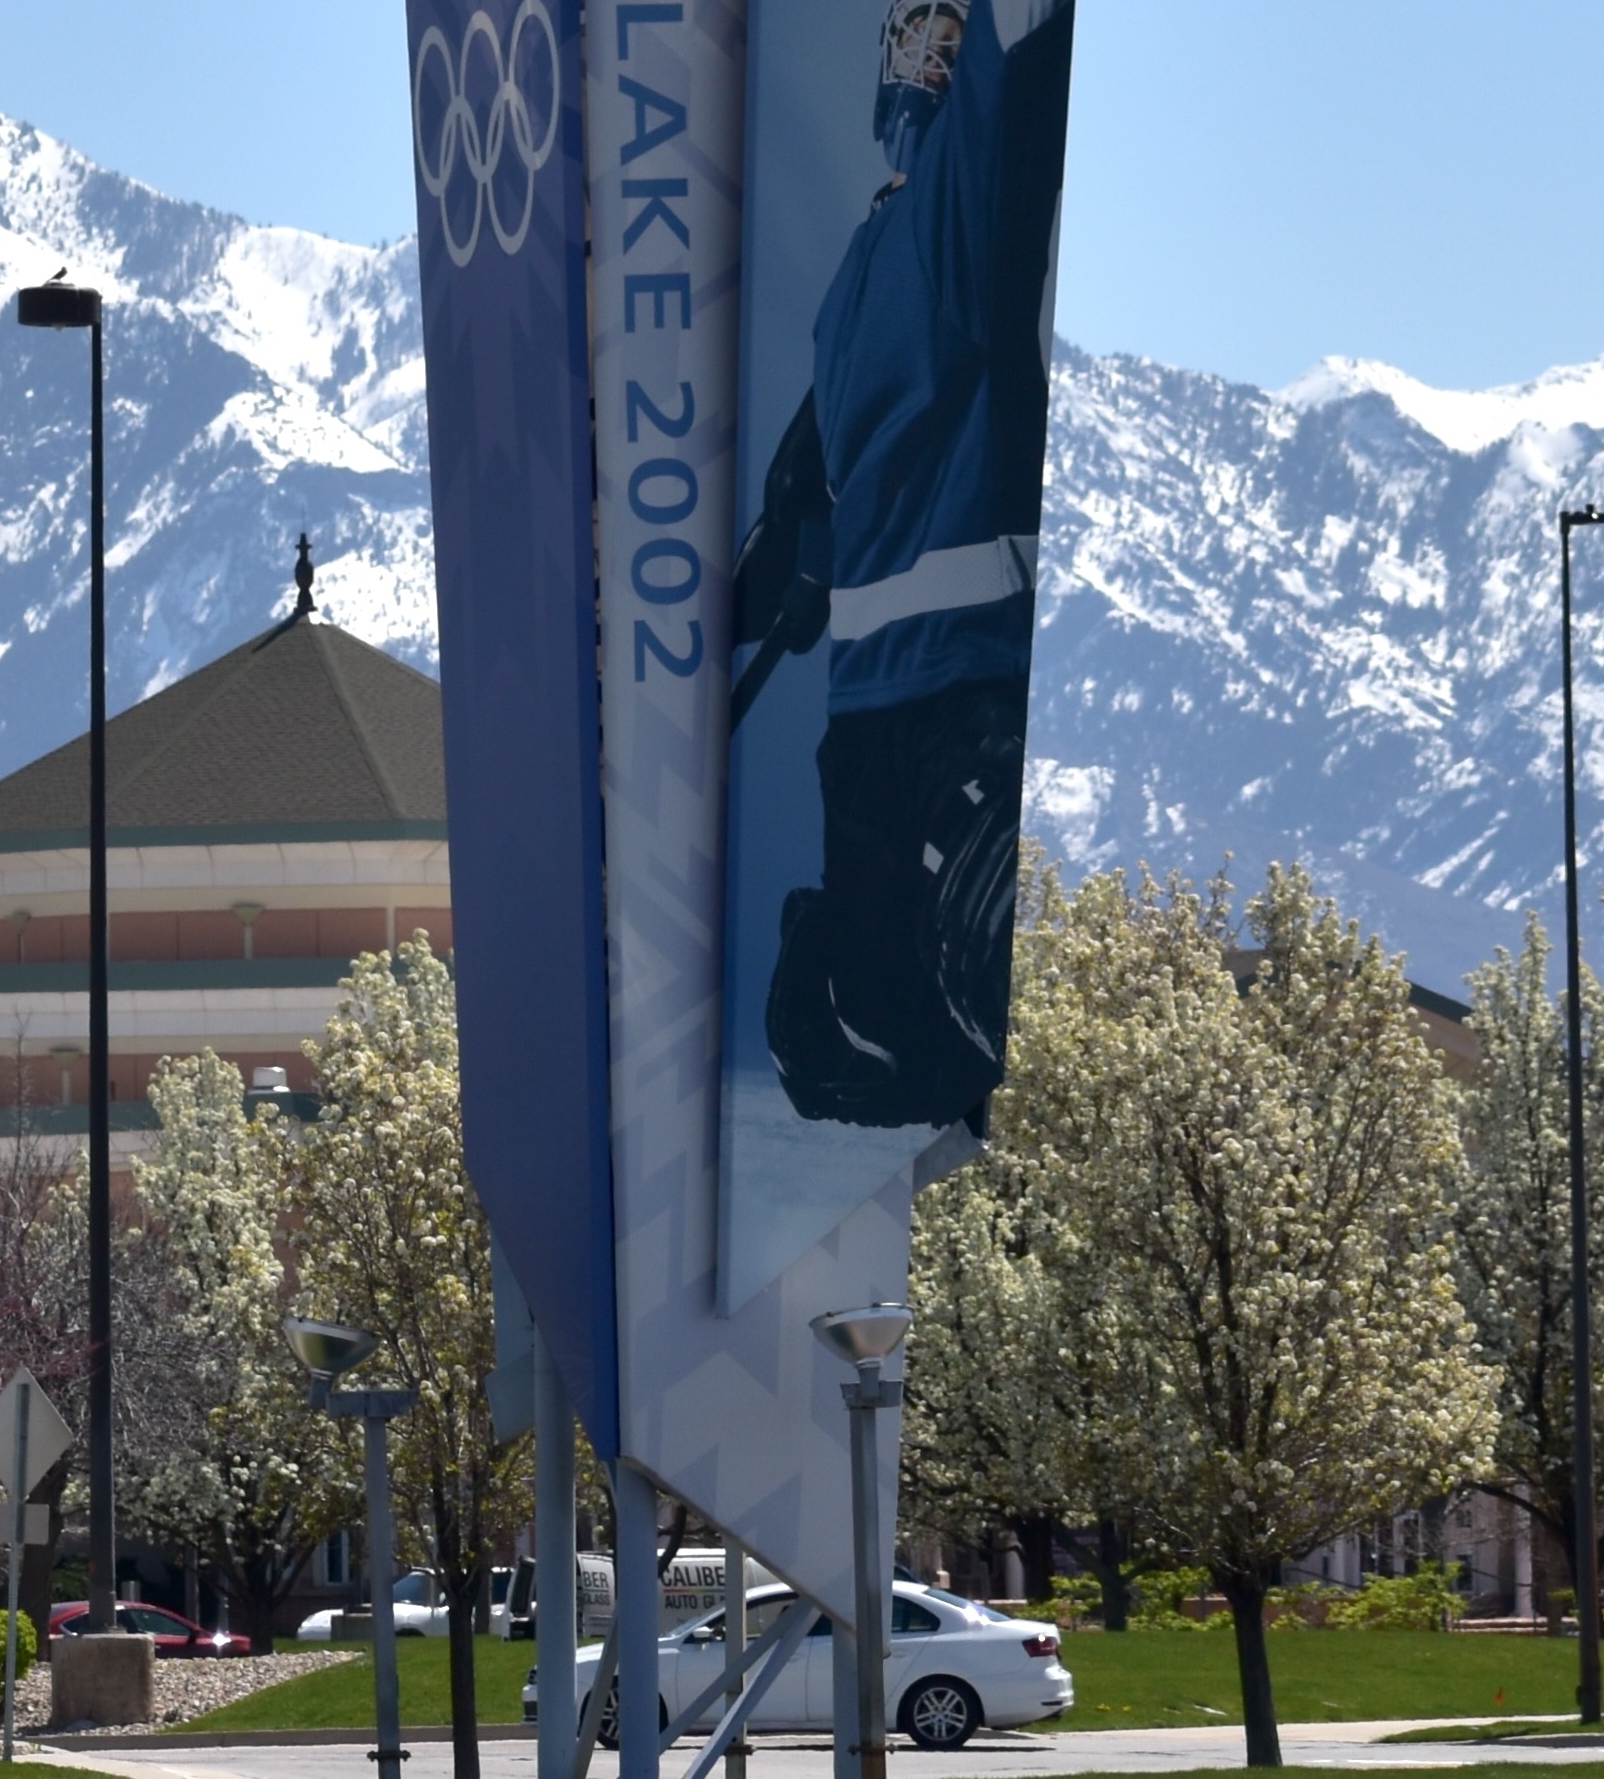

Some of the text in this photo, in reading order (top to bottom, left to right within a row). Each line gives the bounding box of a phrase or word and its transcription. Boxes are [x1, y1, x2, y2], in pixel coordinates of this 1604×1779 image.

[616, 2, 691, 333] LAKE
[626, 379, 704, 683] 2002
[661, 1565, 725, 1587] CALIBE
[665, 1594, 698, 1609] AUTO
